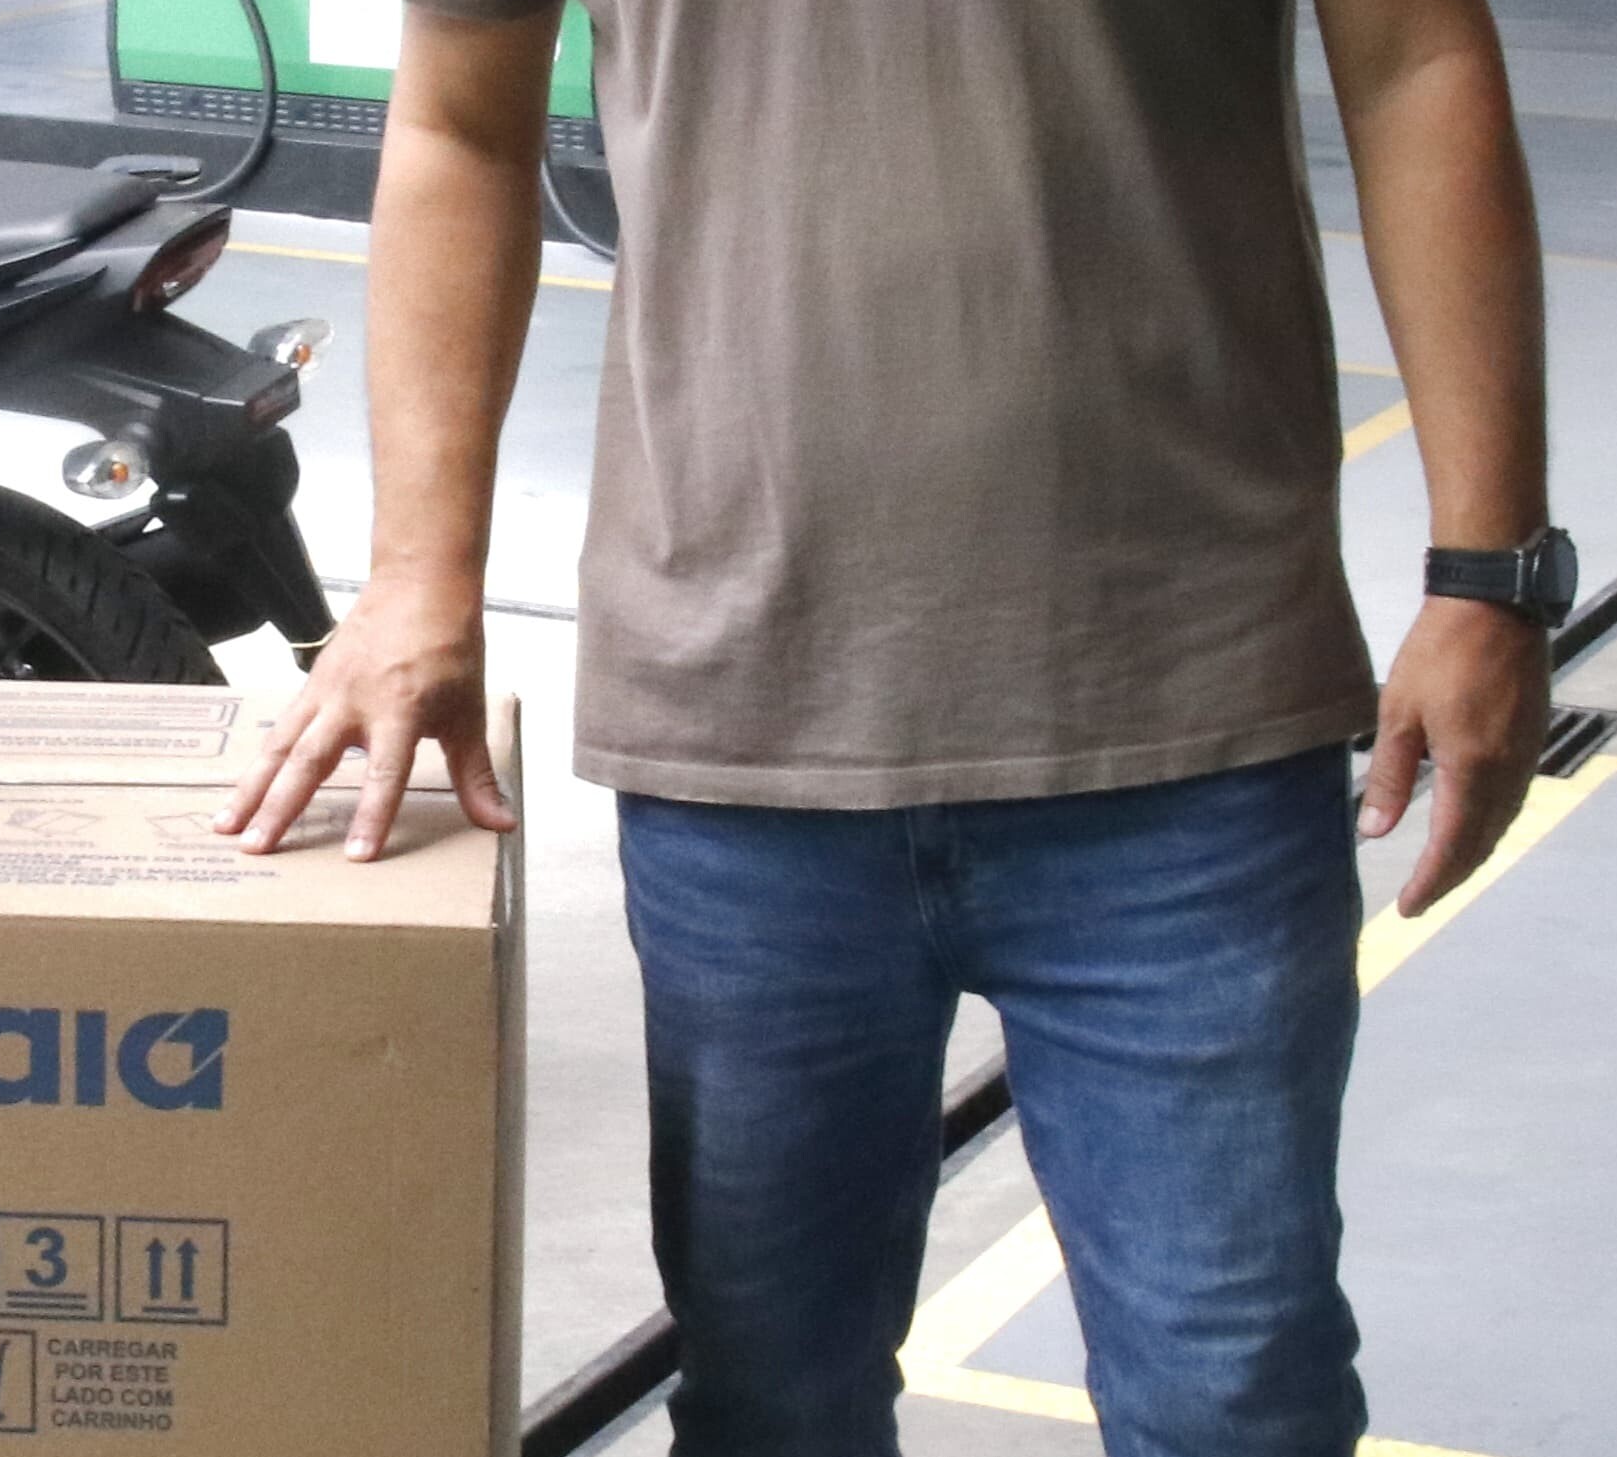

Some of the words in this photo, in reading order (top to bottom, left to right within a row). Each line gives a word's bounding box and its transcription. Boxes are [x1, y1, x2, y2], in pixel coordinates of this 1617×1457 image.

[24, 1227, 69, 1289] 3
[46, 1339, 178, 1361] CARREGAR
[55, 1363, 104, 1383] POR
[110, 1362, 170, 1385] ESTE
[50, 1386, 114, 1407] LADO
[121, 1386, 175, 1408] COM
[51, 1408, 174, 1432] CARRINHO
